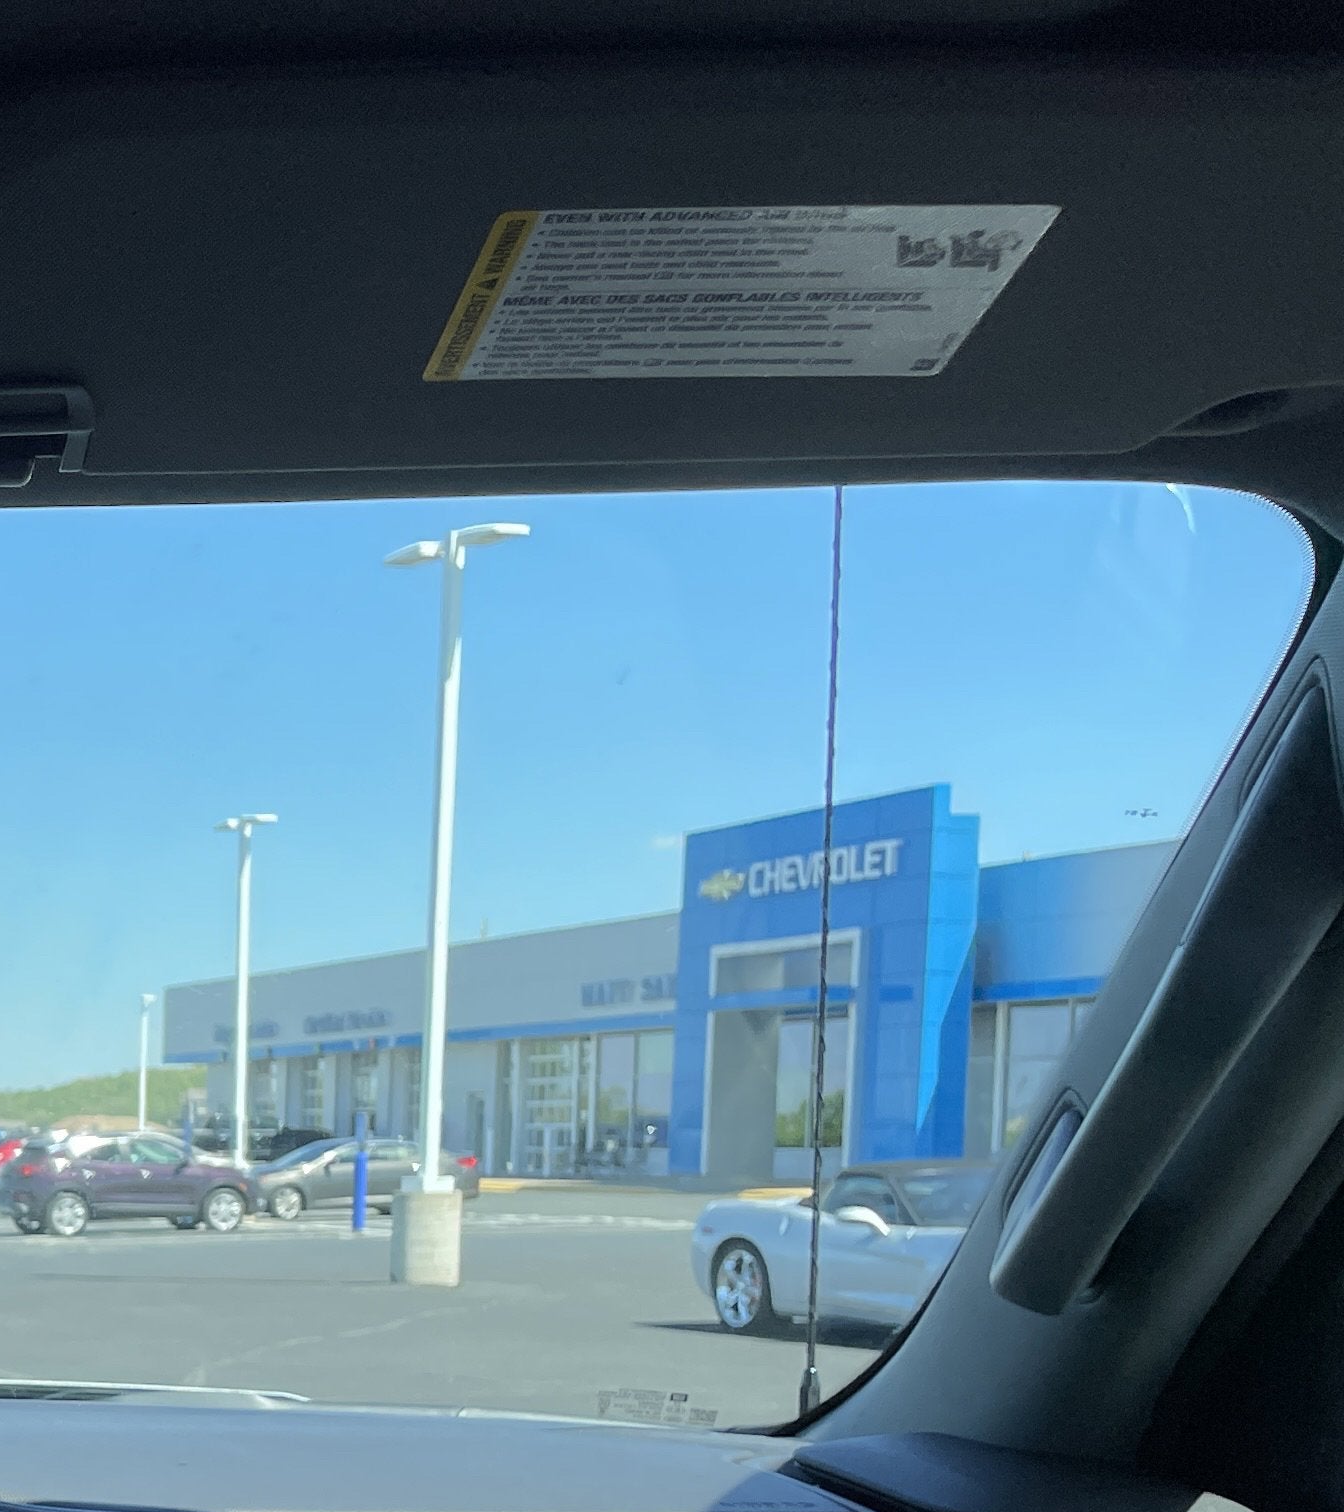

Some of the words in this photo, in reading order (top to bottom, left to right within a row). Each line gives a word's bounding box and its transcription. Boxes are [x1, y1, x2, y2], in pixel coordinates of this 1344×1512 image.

[544, 212, 593, 224] EVEN
[597, 211, 646, 223] WITH
[650, 210, 753, 222] ADVANCED
[558, 294, 603, 306] AVEC
[606, 294, 641, 306] DES
[693, 293, 801, 305] GONFLABLES
[748, 838, 902, 898] CHEVROLET
